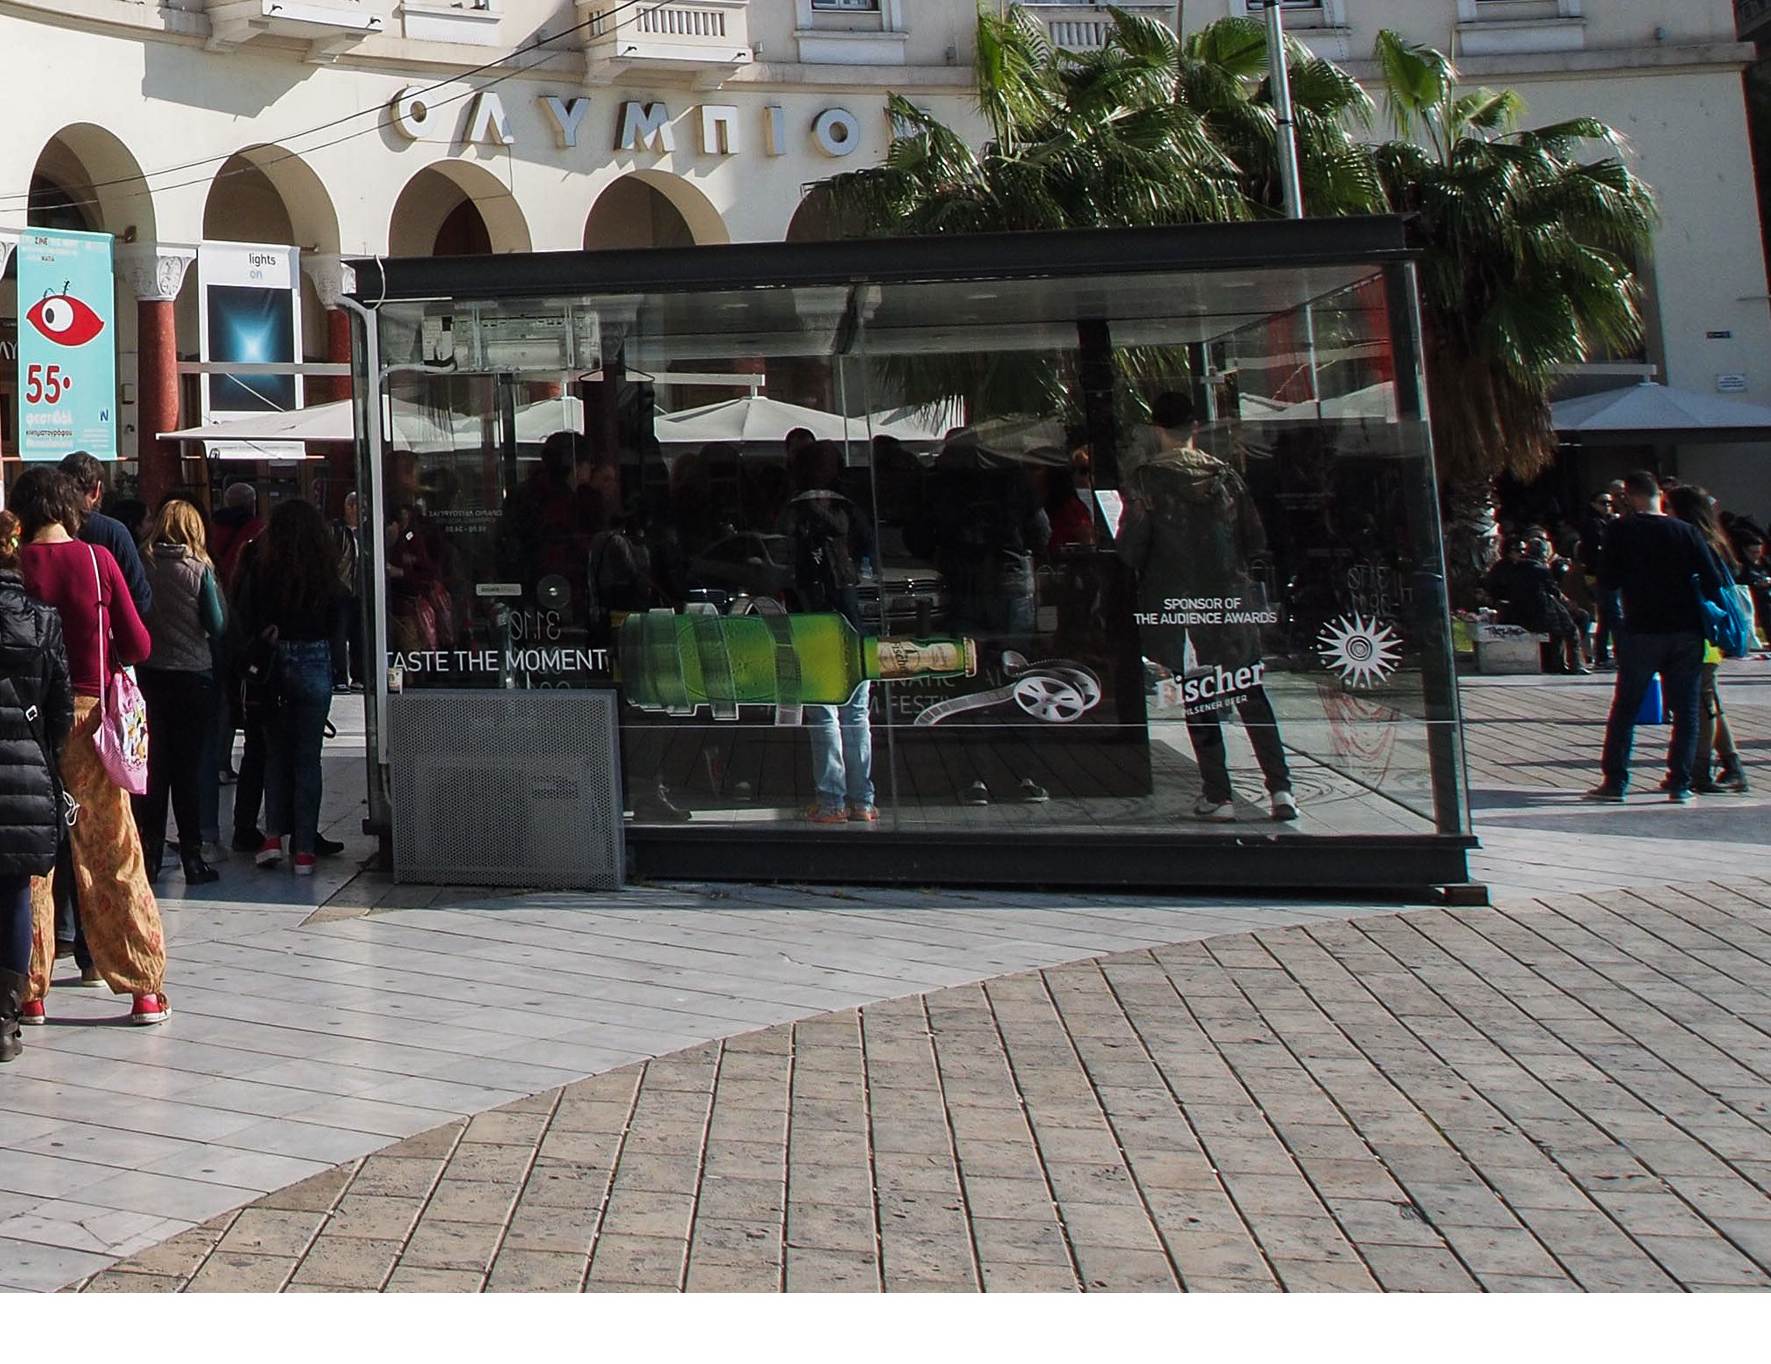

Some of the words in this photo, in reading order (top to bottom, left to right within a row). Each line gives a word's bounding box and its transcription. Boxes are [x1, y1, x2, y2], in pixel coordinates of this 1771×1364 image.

[249, 253, 276, 267] lights
[250, 270, 262, 278] on
[1163, 598, 1223, 610] SPONSOR
[1225, 597, 1242, 610] OF
[1133, 613, 1159, 625] THE
[1160, 612, 1223, 625] AUDIENCE
[1224, 611, 1278, 624] AWARDS
[453, 651, 499, 672] THE
[505, 649, 607, 671] MOMENT
[1155, 661, 1266, 710] Fischer
